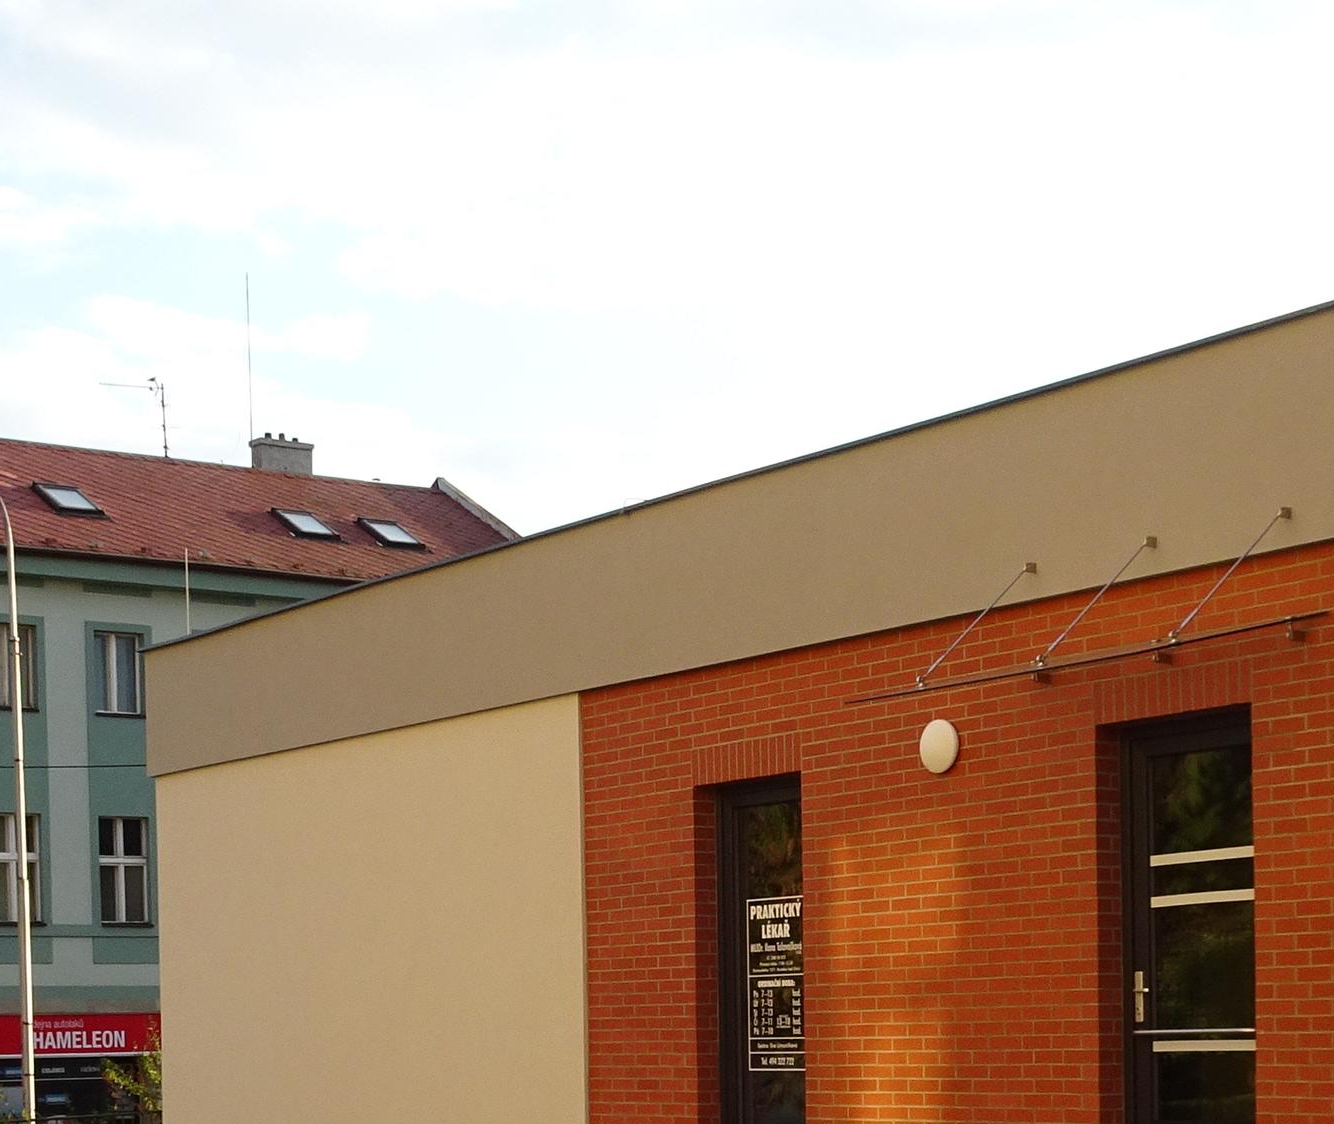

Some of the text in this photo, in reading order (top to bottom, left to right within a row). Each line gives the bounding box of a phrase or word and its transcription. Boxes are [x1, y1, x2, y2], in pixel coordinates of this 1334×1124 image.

[750, 899, 801, 920] PRAKTICKÝ
[761, 919, 791, 939] LÉKAŘ
[33, 1030, 126, 1050] HAMELEON
